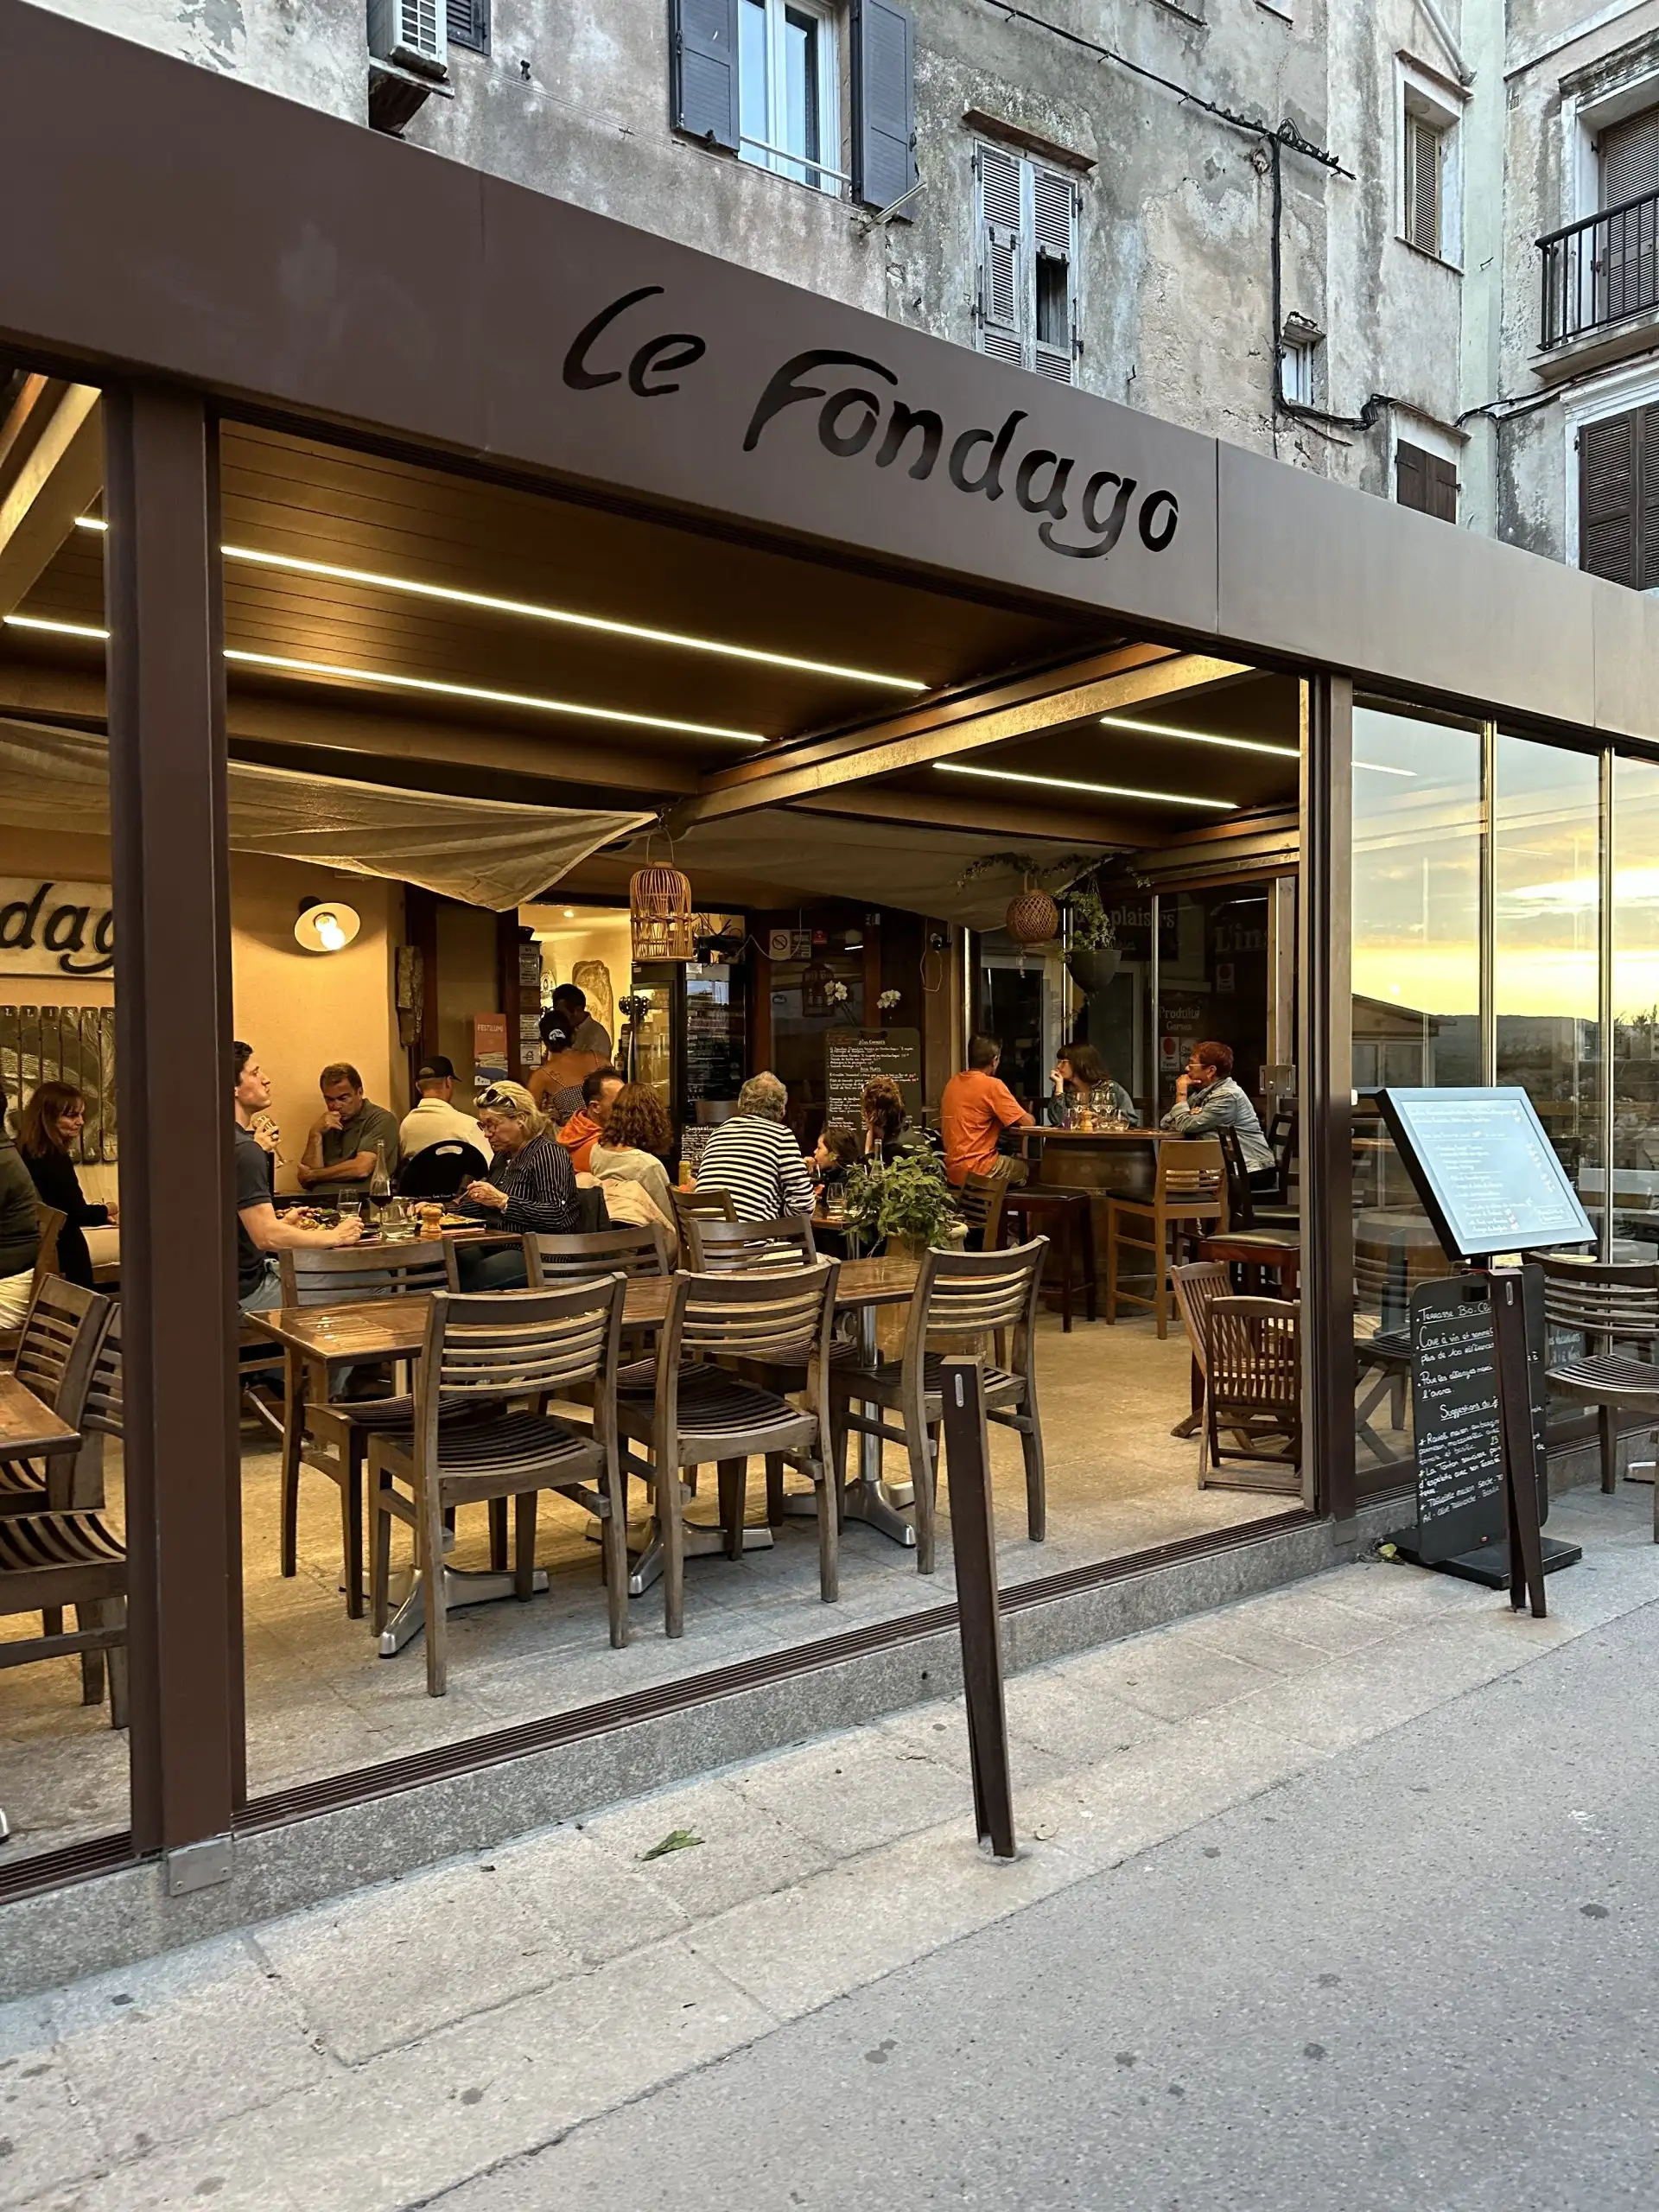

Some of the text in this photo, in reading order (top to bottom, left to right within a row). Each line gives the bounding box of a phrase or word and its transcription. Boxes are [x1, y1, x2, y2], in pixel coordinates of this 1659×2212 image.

[562, 285, 1179, 559] Le Fondago
[1110, 906, 1175, 930] plaisrs
[1418, 1306, 1454, 1321] Terrasse
[1419, 1325, 1440, 1348] Cave
[1441, 1332, 1448, 1344] à
[1449, 1333, 1460, 1343] vin
[1462, 1332, 1470, 1340] et
[1421, 1353, 1435, 1366] plus
[1438, 1351, 1446, 1359] de
[1440, 1402, 1480, 1419] Suggestions
